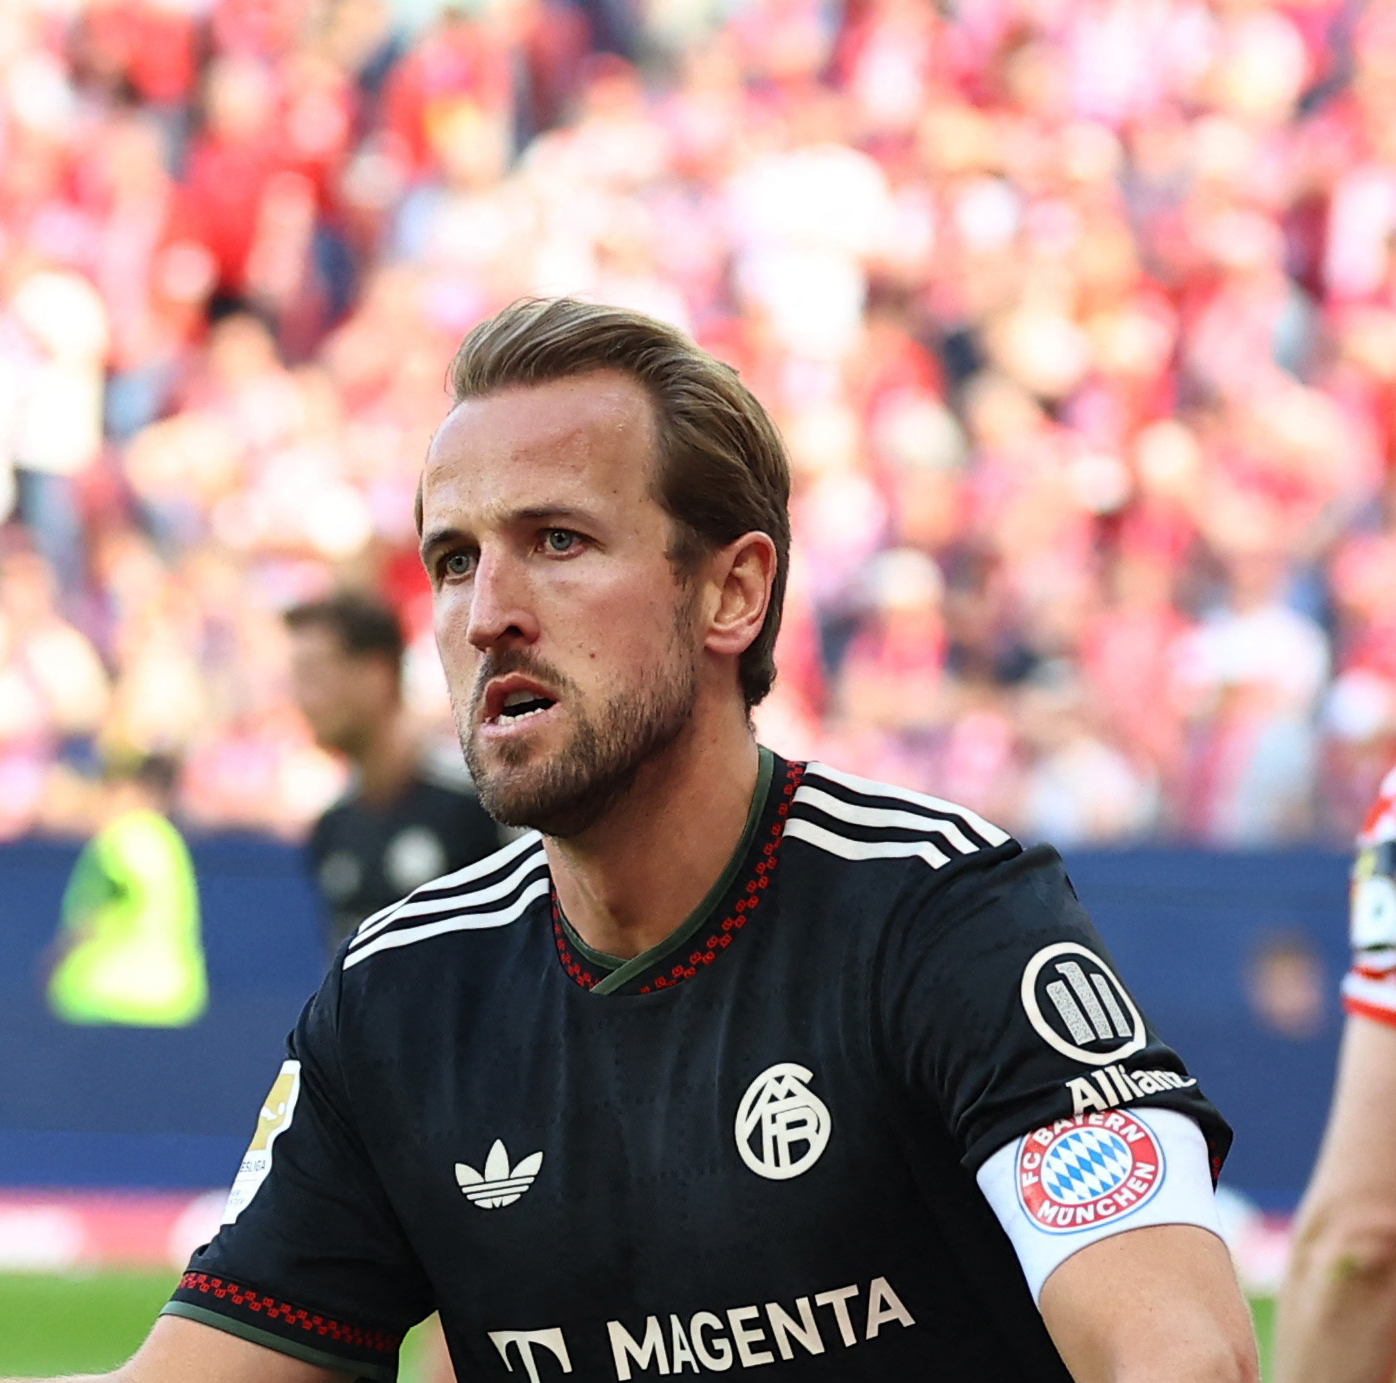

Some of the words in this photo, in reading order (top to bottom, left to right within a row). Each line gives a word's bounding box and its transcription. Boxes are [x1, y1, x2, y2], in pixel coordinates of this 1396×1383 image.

[1065, 1063, 1197, 1116] Allianz
[1021, 1152, 1042, 1187] FC
[1037, 1161, 1156, 1226] MÜNCHEN
[606, 1276, 916, 1381] MAGENTA
